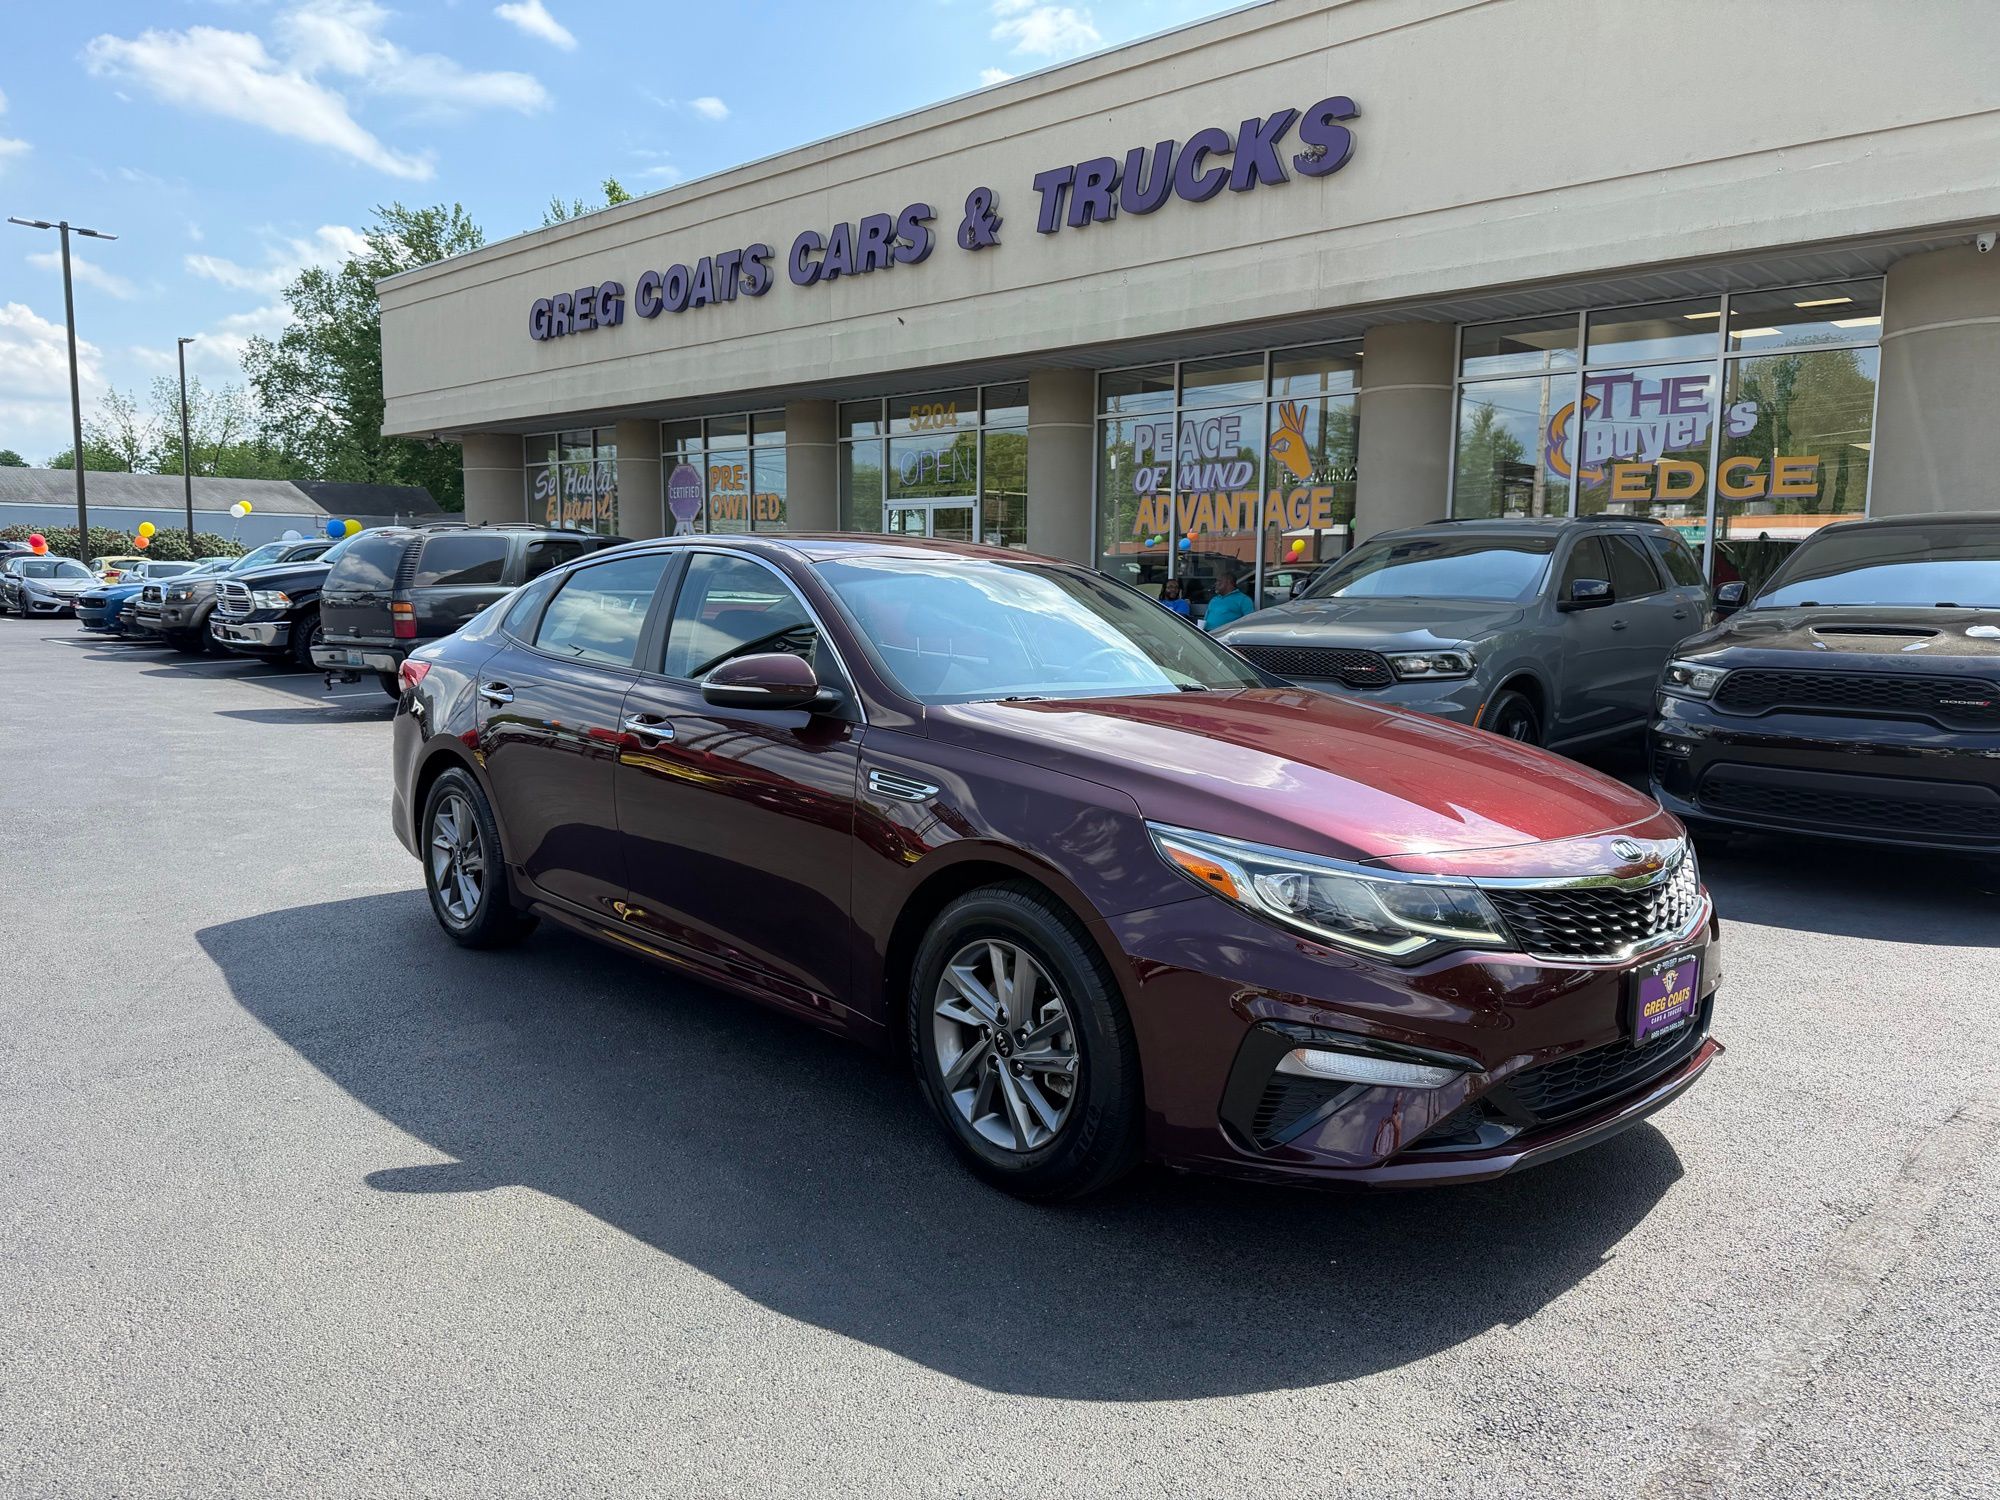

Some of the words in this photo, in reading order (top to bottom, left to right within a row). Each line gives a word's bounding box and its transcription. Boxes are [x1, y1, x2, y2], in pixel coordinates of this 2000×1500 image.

[529, 280, 625, 341] GREG
[635, 243, 775, 319] COATS
[788, 202, 937, 286] CARS
[957, 186, 1001, 251] &
[1033, 95, 1361, 235] TRUCKS
[1585, 372, 1710, 420] THE
[909, 401, 958, 432] 5204
[1582, 401, 1758, 467] Buyer's
[1134, 415, 1241, 464] PEACE
[534, 469, 557, 501] Se
[564, 464, 615, 495] Habla
[709, 465, 748, 492] PRE-
[901, 447, 972, 486] OPEN
[1132, 466, 1168, 493] OF
[1177, 461, 1254, 493] MIND
[1610, 454, 1820, 500] EDGE
[669, 485, 700, 500] CERTIFIED
[710, 493, 780, 521] OWNED
[1132, 486, 1334, 536] ADVANTAGE
[1643, 996, 1667, 1018] GREG
[1667, 986, 1691, 1007] COATS
